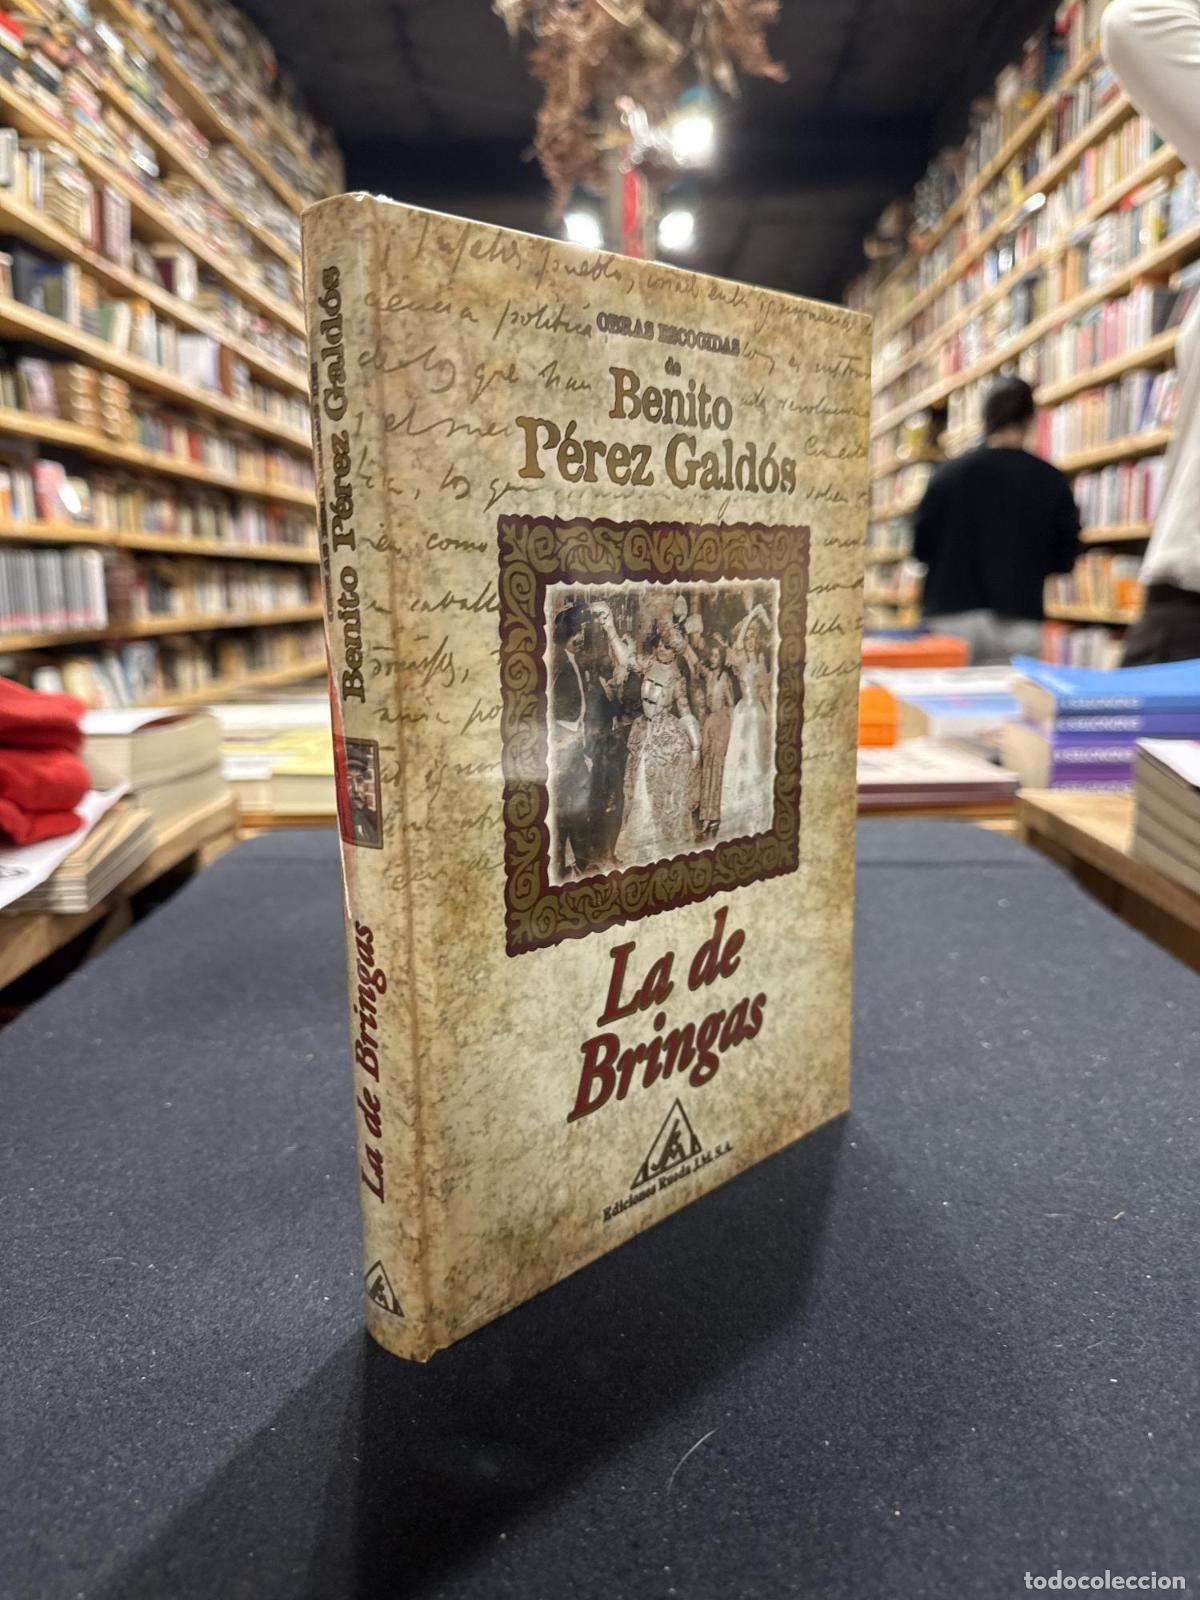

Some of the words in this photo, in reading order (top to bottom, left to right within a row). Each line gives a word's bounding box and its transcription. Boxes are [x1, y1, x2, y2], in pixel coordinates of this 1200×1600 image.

[318, 265, 348, 421] Galdós
[597, 312, 654, 341] OBRAS
[609, 366, 733, 430] Benito
[329, 429, 357, 552] Pérez
[515, 415, 654, 487] Pérez
[664, 433, 796, 494] Galdós
[337, 566, 366, 703] Benito
[354, 920, 387, 1083] Bringas
[597, 940, 675, 1027] La
[687, 905, 745, 992] de
[566, 992, 767, 1123] Bringas
[357, 1086, 383, 1139] de
[360, 1143, 385, 1204] La
[602, 1183, 657, 1222] Ediciones
